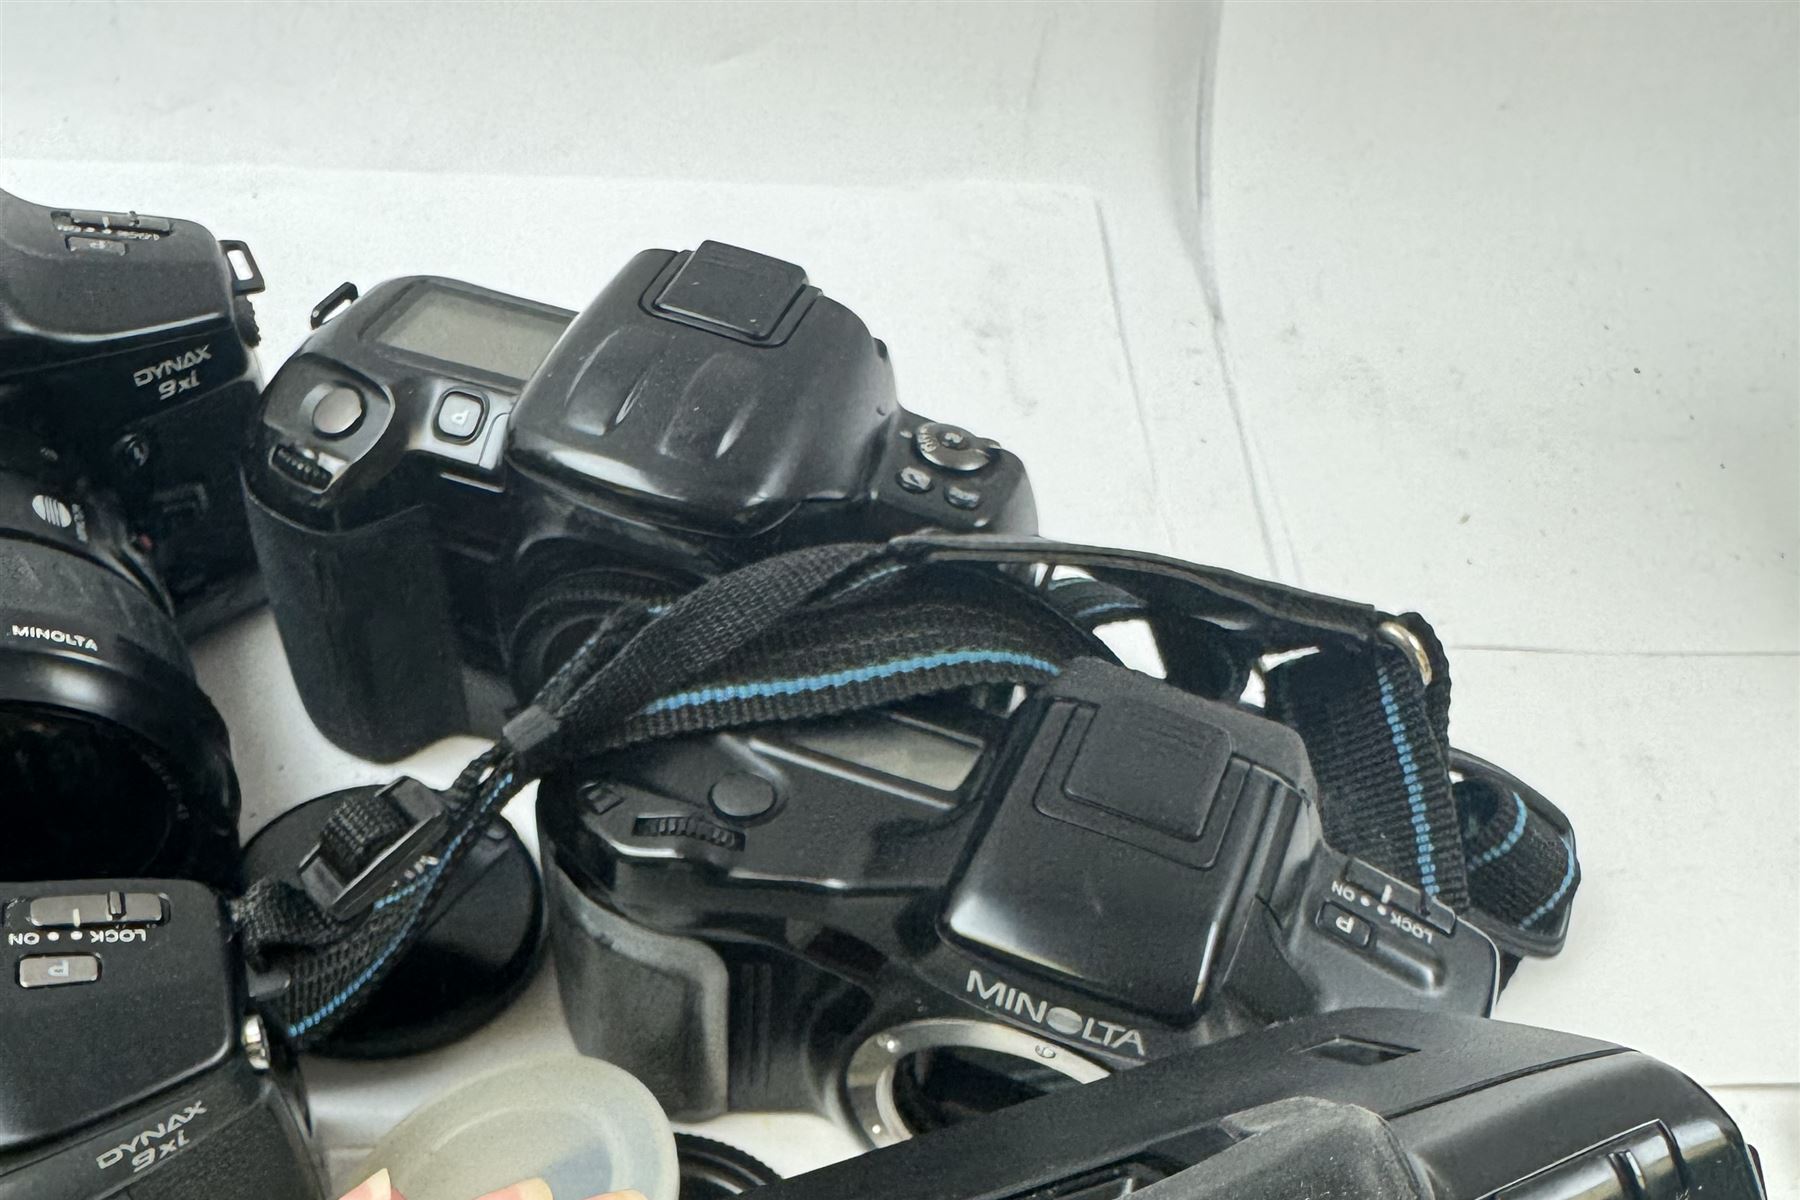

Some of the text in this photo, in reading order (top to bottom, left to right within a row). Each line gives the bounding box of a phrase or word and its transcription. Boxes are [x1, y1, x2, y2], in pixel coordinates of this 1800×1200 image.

[133, 344, 212, 387] DYNAX
[12, 624, 98, 651] MINOLTA
[1331, 880, 1433, 944] LOCK ON
[1335, 916, 1355, 934] P
[8, 929, 147, 946] LOCK ON
[966, 970, 1145, 1056] MINOLTA
[96, 1101, 207, 1169] DYNAX
